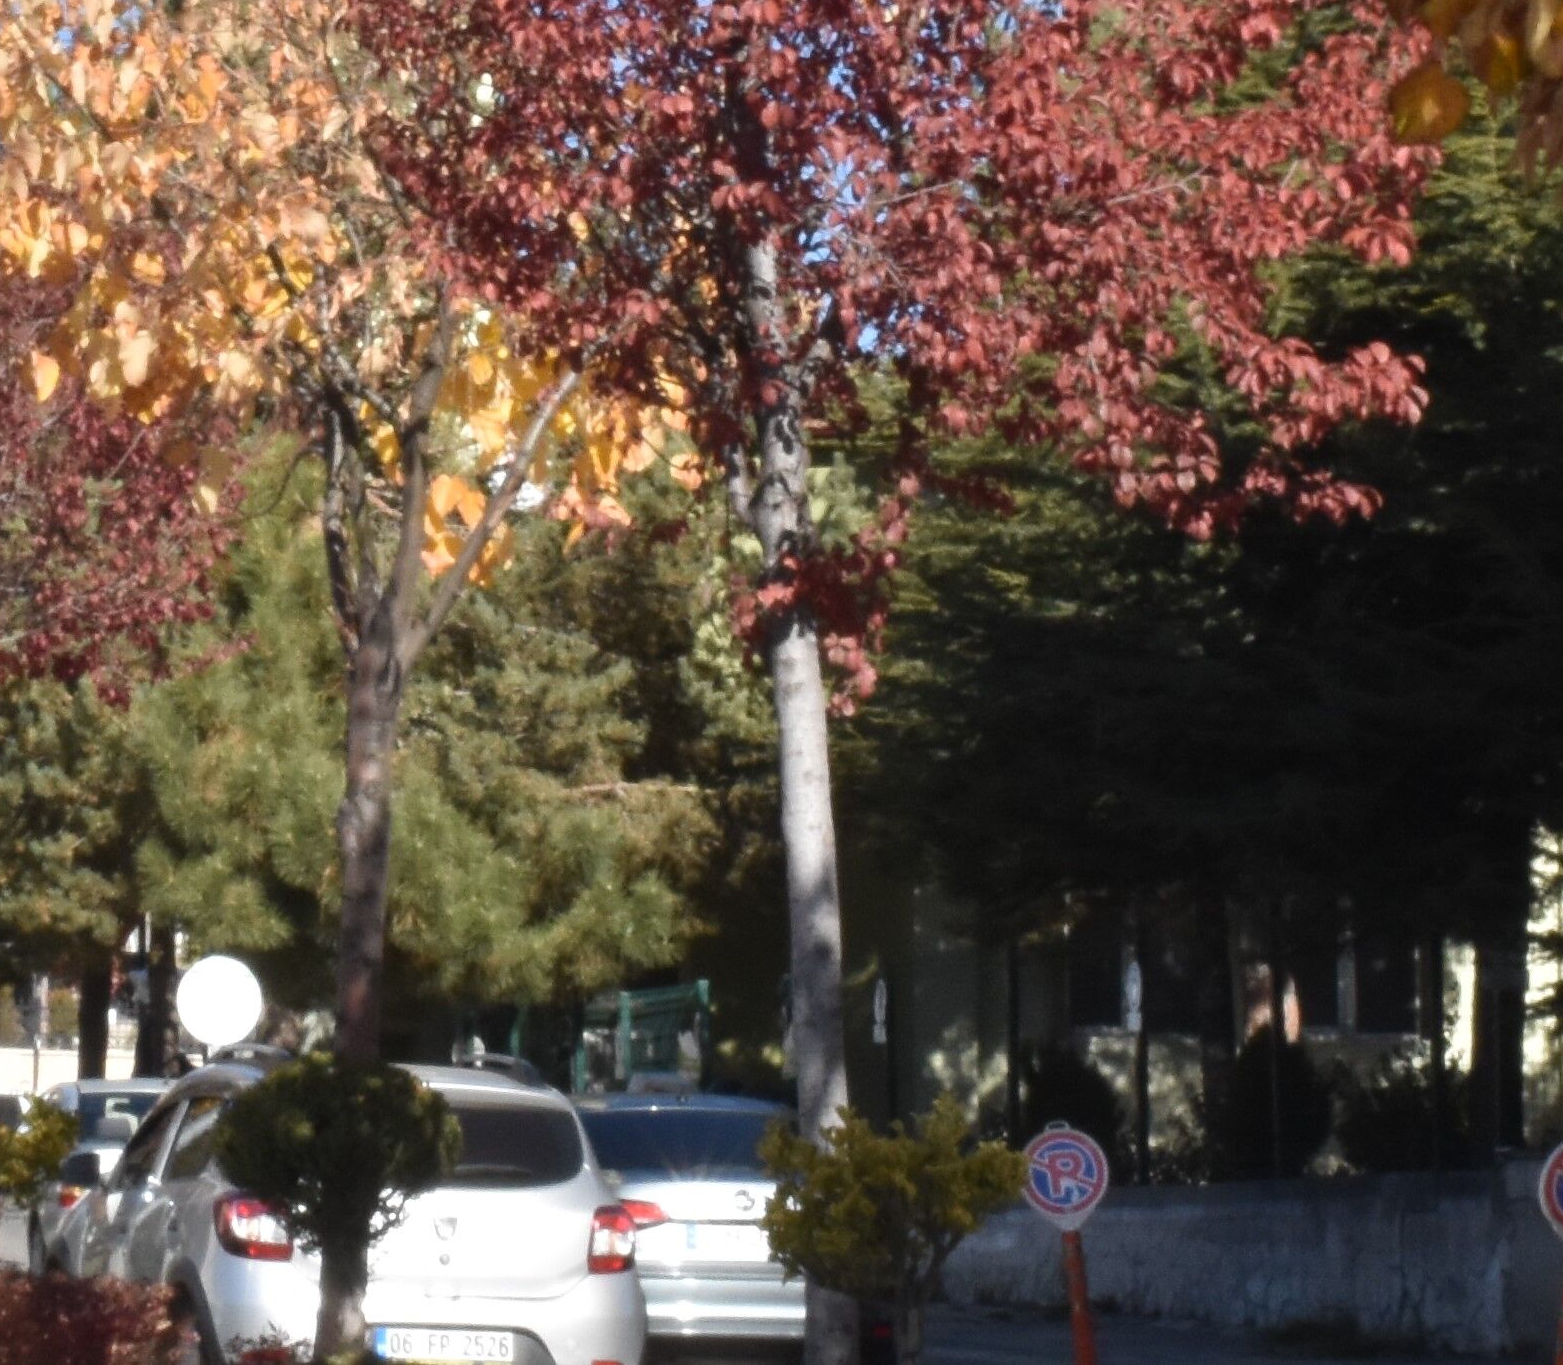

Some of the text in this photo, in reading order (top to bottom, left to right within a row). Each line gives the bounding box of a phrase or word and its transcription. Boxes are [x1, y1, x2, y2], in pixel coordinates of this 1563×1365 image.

[390, 1333, 508, 1357] 06 FP 2526
